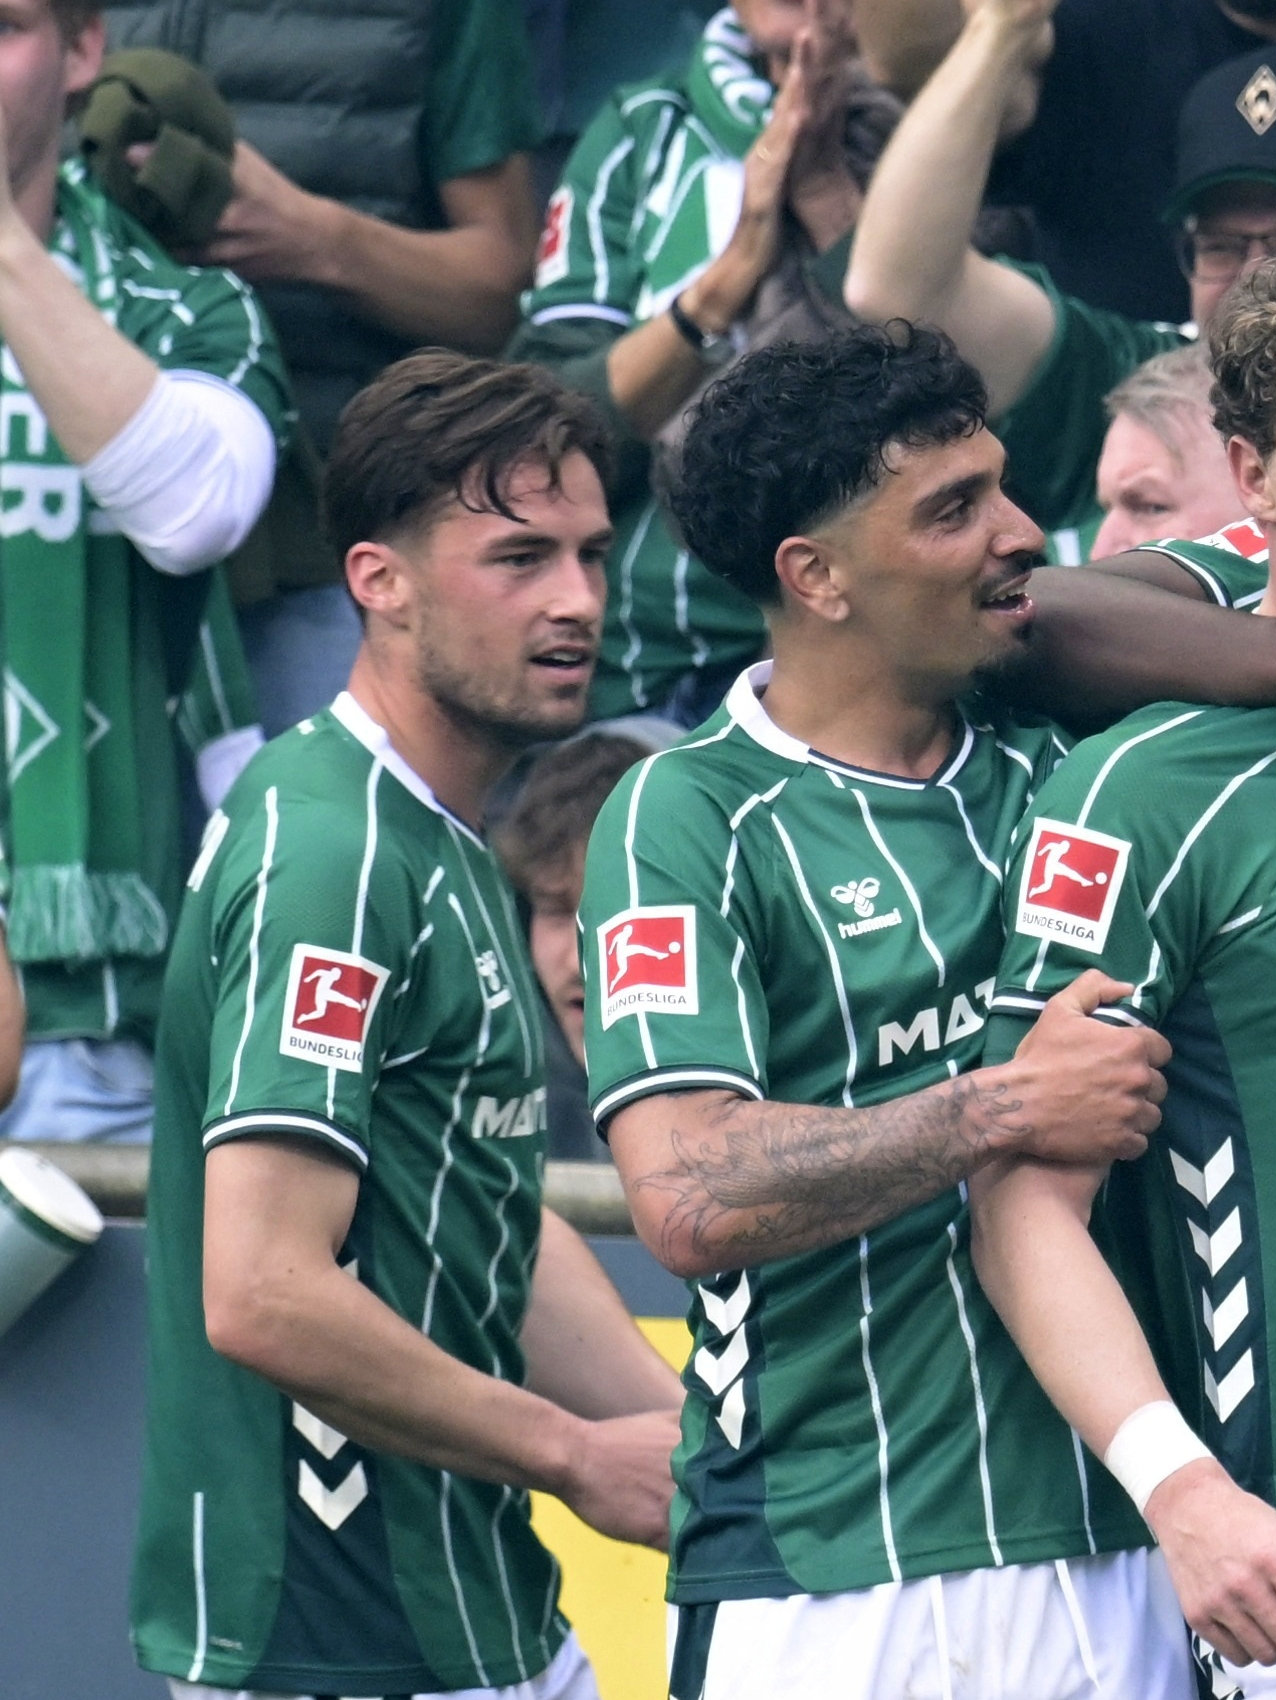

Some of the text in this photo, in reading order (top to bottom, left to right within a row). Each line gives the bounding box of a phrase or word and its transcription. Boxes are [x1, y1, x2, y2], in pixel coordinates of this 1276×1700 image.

[837, 907, 903, 940] hummel
[1022, 911, 1096, 942] BUNDESLIGA
[607, 991, 687, 1017] BUNDESLIGA
